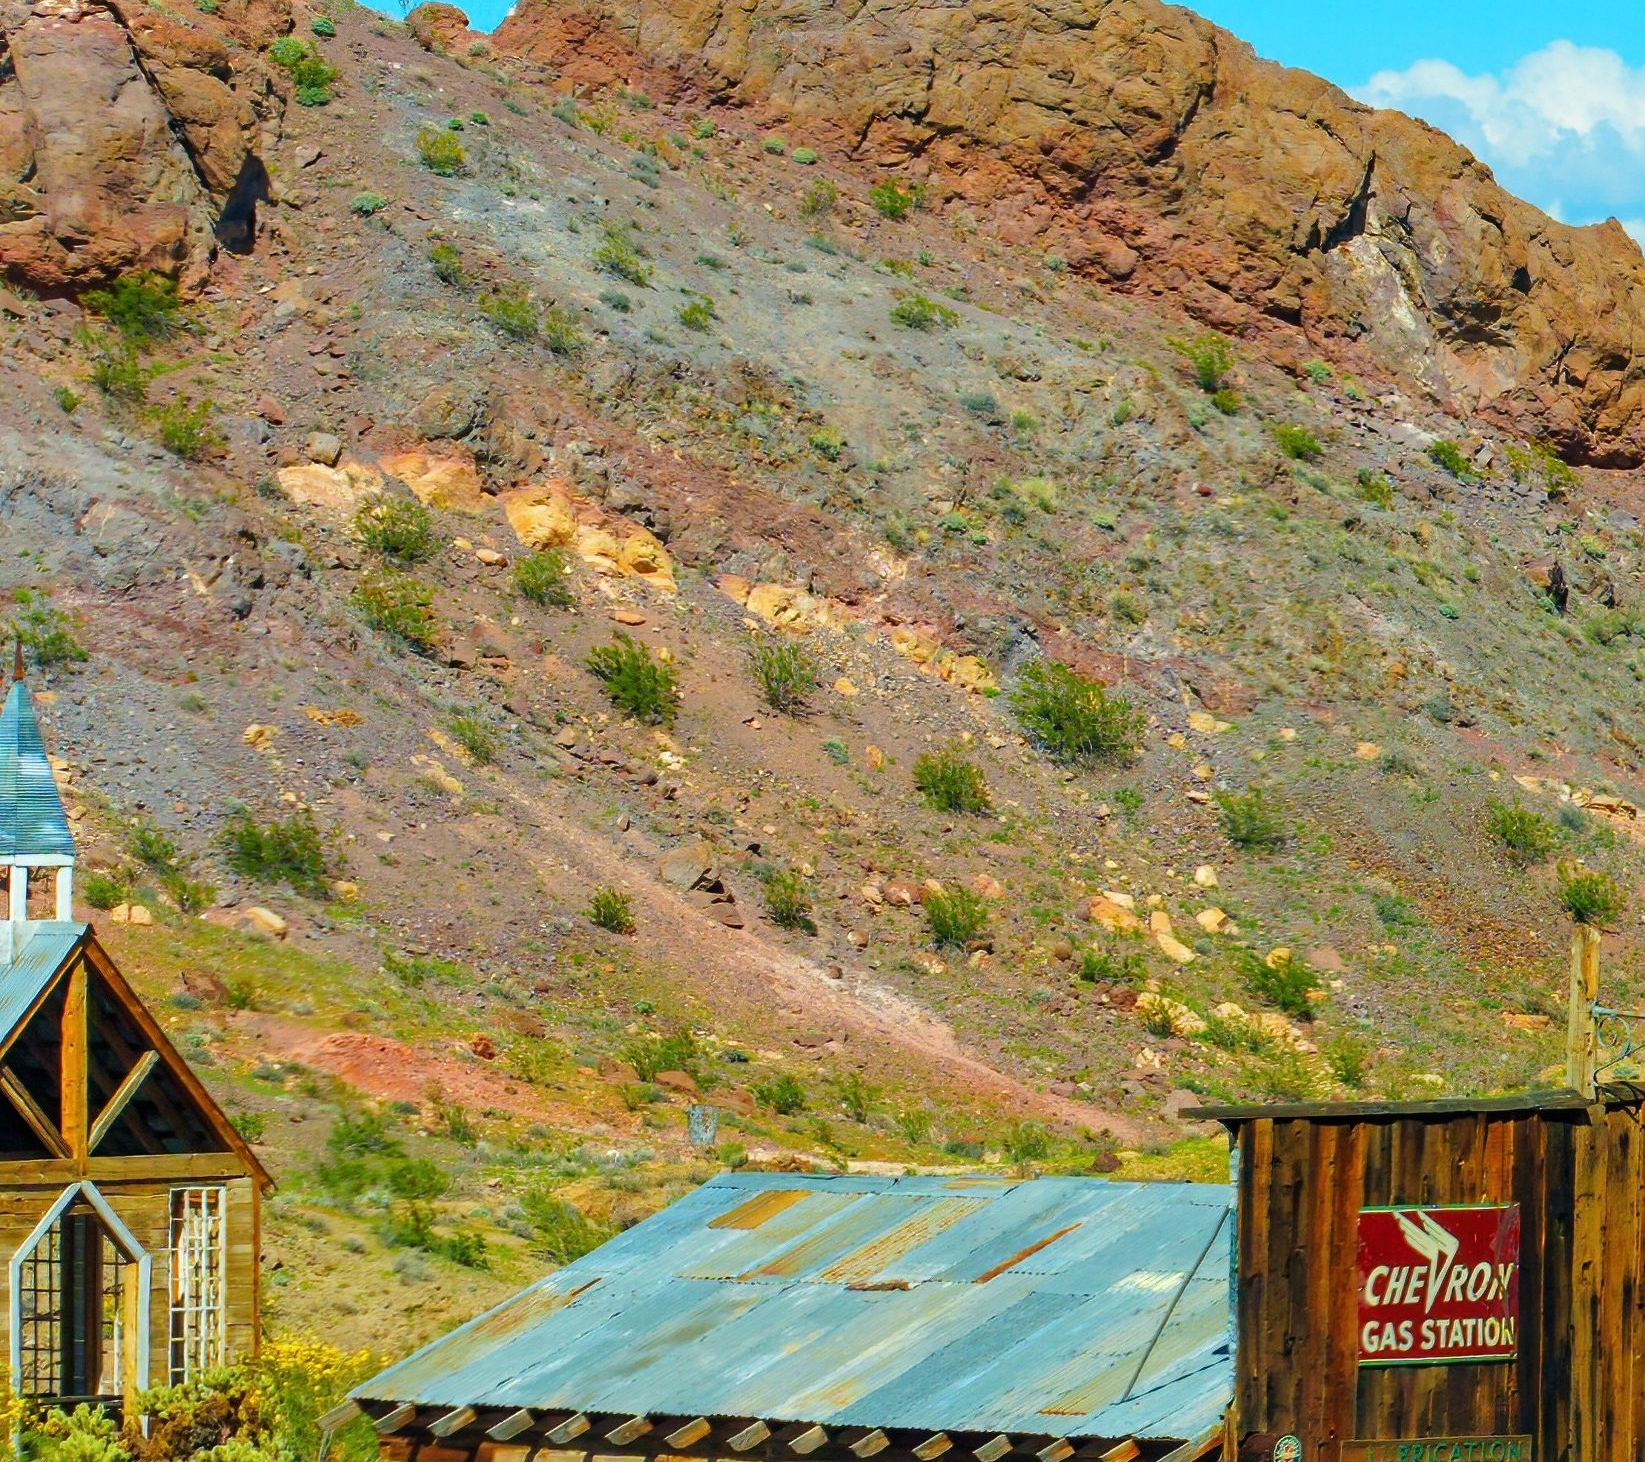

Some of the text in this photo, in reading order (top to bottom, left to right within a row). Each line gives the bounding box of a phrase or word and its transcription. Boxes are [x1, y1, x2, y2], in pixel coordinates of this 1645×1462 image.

[1365, 1253, 1515, 1314] CHEVRON
[1362, 1316, 1515, 1353] GAS STATION
